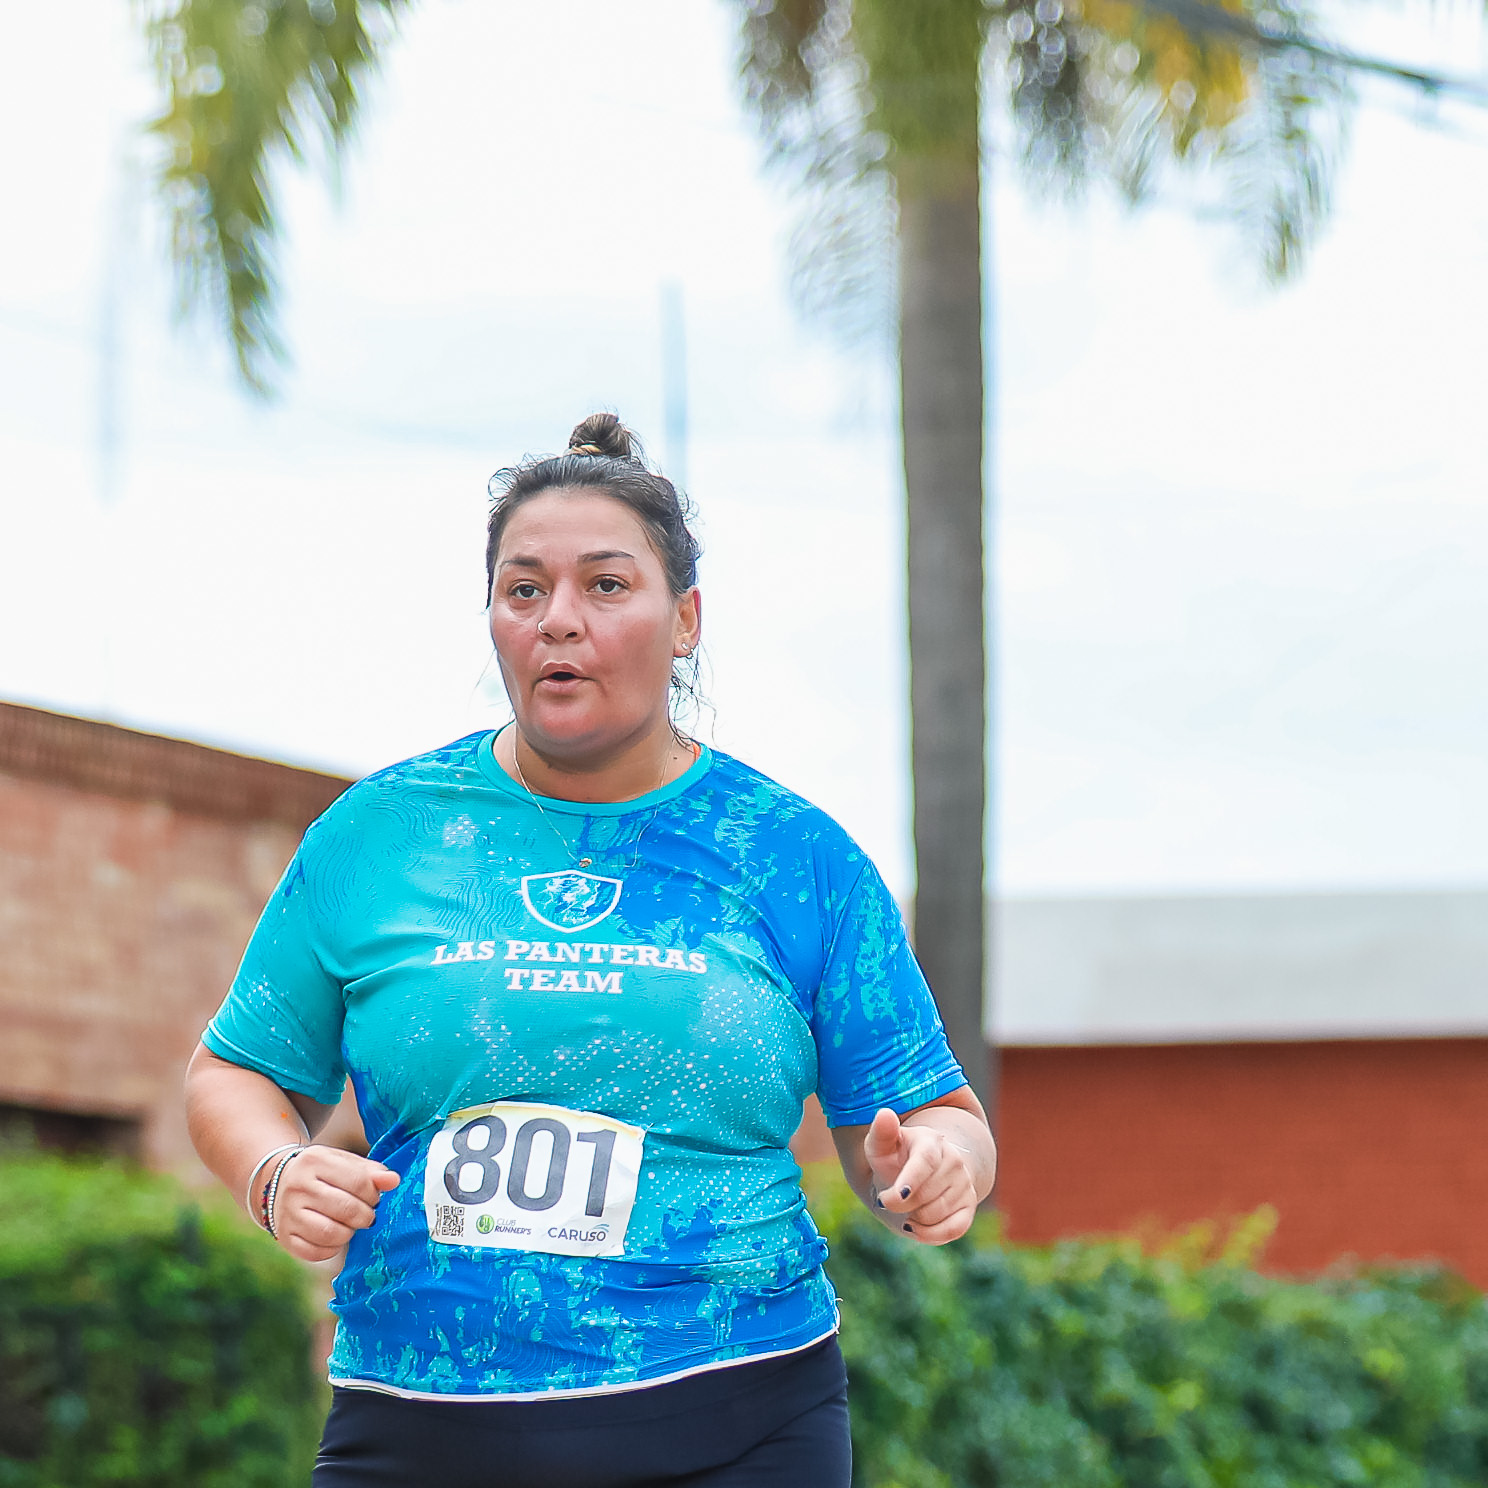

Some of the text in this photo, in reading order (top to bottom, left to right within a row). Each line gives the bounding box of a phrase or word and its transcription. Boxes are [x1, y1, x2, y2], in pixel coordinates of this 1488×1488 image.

[430, 940, 707, 974] LAS PANTERAS
[504, 968, 624, 994] TEAM
[443, 1114, 618, 1218] 801
[547, 1227, 607, 1242] CARUSO
